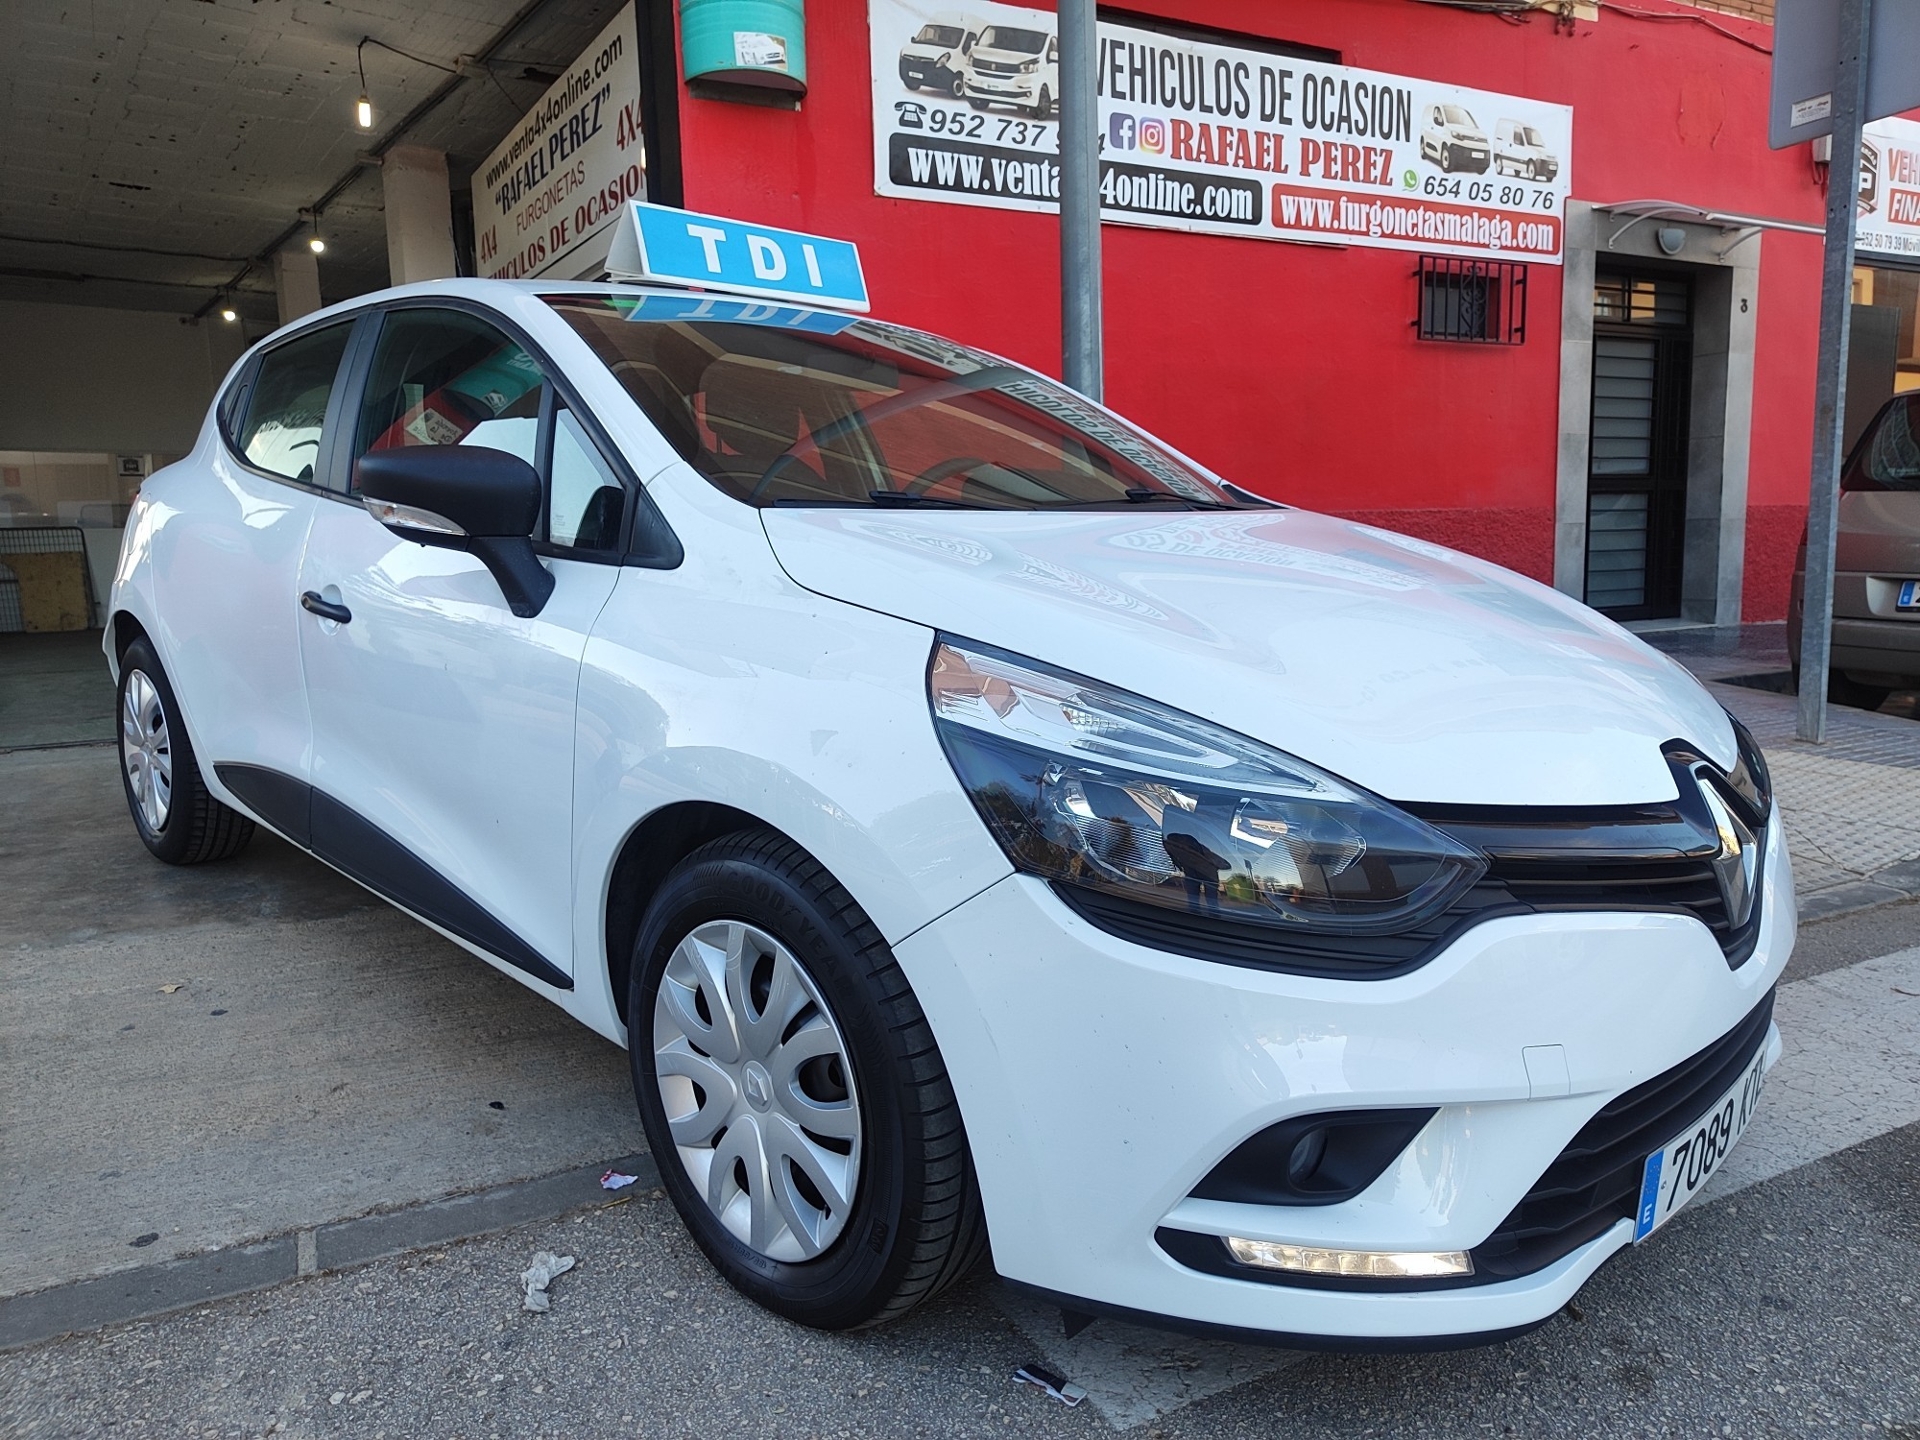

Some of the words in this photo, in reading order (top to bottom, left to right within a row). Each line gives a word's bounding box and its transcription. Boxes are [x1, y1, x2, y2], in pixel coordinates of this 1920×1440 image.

[486, 34, 622, 189] www.venta4x4online.com
[929, 109, 984, 139] 952
[996, 118, 1046, 147] 737
[1259, 66, 1293, 126] DE
[1302, 73, 1412, 143] OCASION
[907, 147, 1253, 220] www.venta4online.com
[1170, 118, 1288, 174] RAFAEL
[1299, 137, 1394, 187] PEREZ
[516, 160, 586, 236] FURGONETAS
[1280, 193, 1554, 252] www.furgonetasmalaga.com
[1424, 176, 1461, 199] 654
[1468, 182, 1493, 202] 05
[1500, 186, 1524, 206] 80
[1532, 190, 1554, 210] 76
[481, 224, 498, 264] 4X4
[550, 217, 571, 254] DE
[1666, 1098, 1735, 1213] 7089
[1642, 1203, 1652, 1225] E
